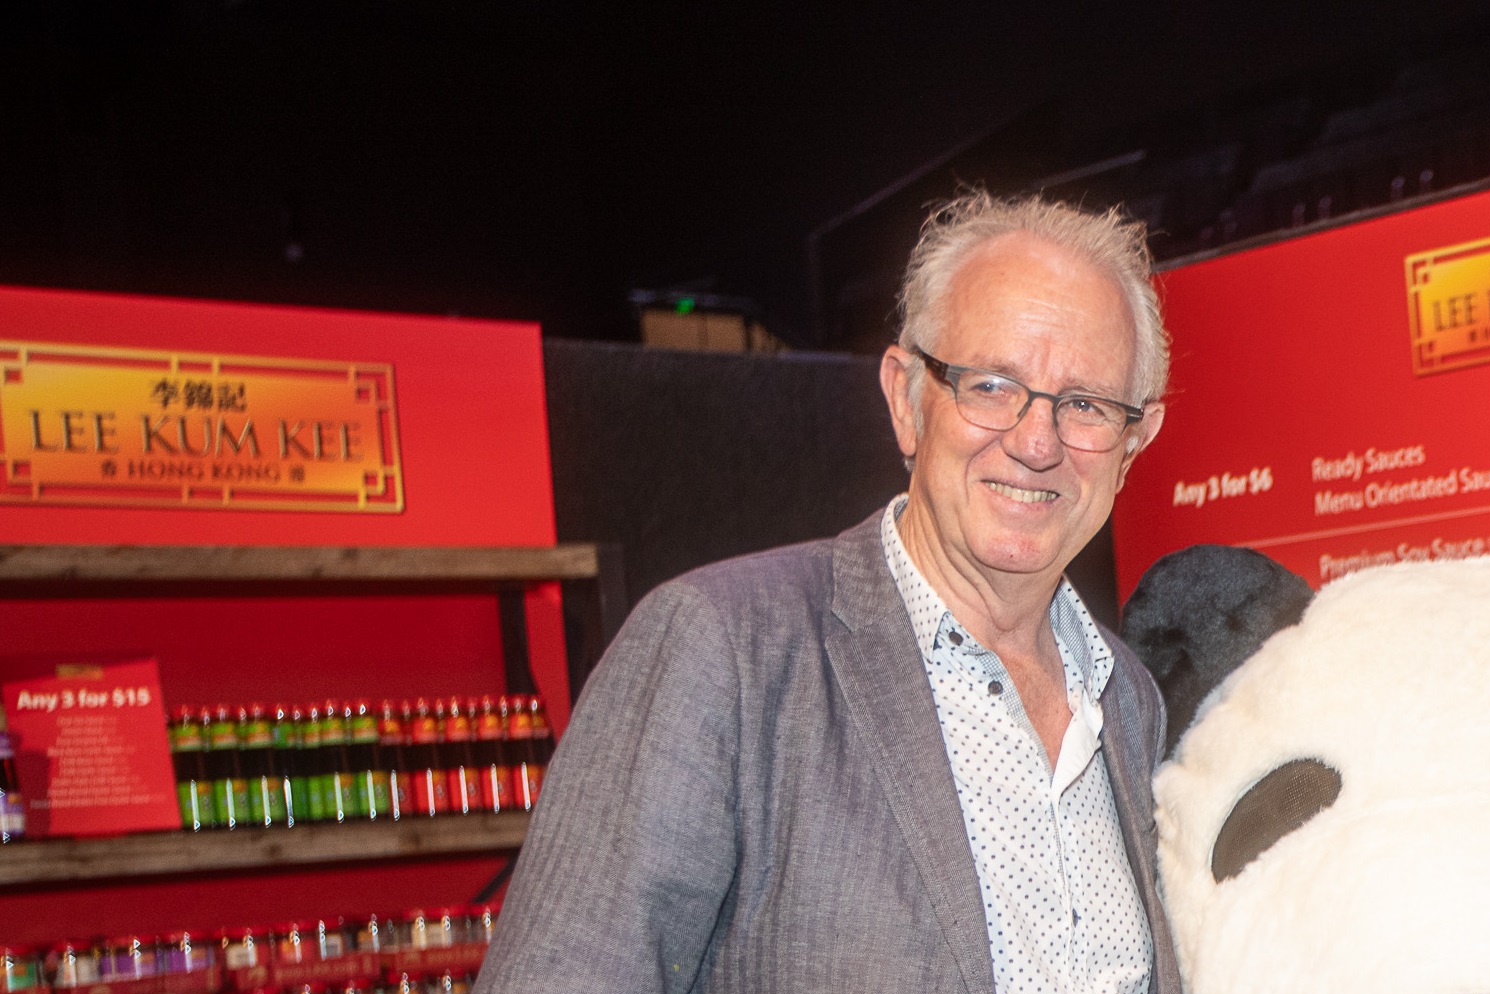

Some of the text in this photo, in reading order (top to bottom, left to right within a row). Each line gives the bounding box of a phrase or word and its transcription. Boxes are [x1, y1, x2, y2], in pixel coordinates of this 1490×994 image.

[1433, 294, 1477, 332] LEE
[29, 409, 363, 461] LEE KUM KEE
[127, 460, 205, 481] HONG
[211, 463, 281, 483] KONG
[1312, 445, 1426, 482] Ready Sauces
[1173, 467, 1273, 508] Any 3 for $6
[1315, 490, 1363, 515] Menu
[1365, 471, 1457, 508] Orientated
[1432, 538, 1485, 561] Sauce
[17, 686, 151, 712] Any 3 for $15
